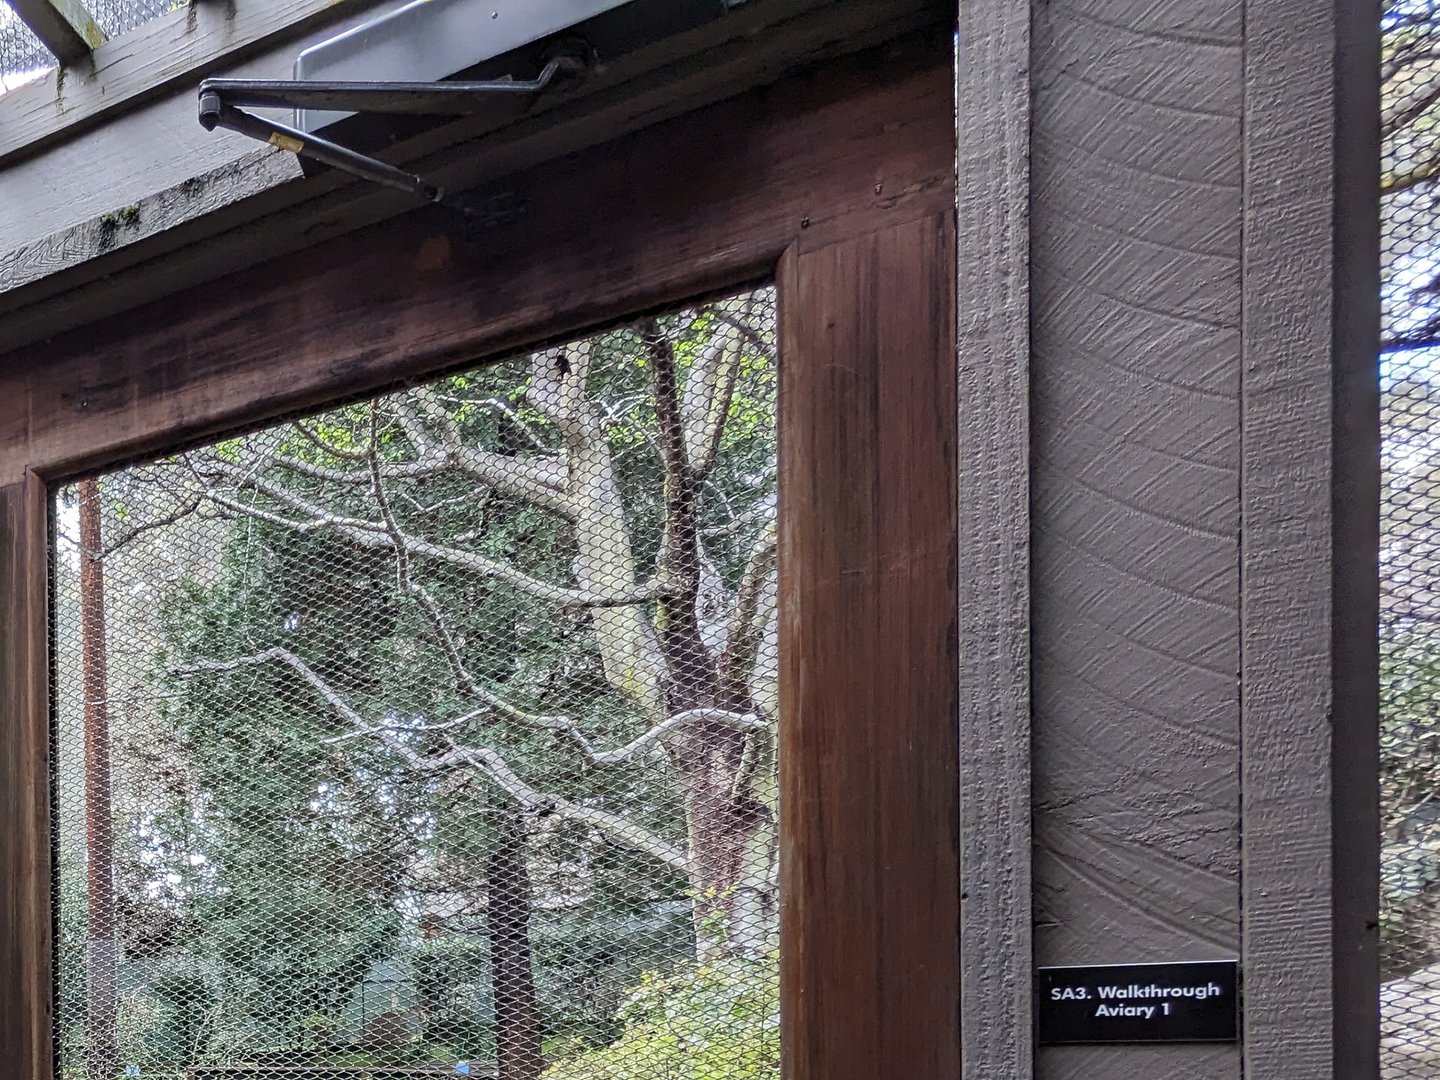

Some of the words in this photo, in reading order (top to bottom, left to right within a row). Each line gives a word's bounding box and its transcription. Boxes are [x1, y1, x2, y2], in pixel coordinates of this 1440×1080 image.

[1051, 987, 1092, 1000] SA3.
[1098, 982, 1220, 999] Walkthrough
[1095, 1004, 1154, 1019] Aviary
[1162, 1003, 1170, 1015] 1
